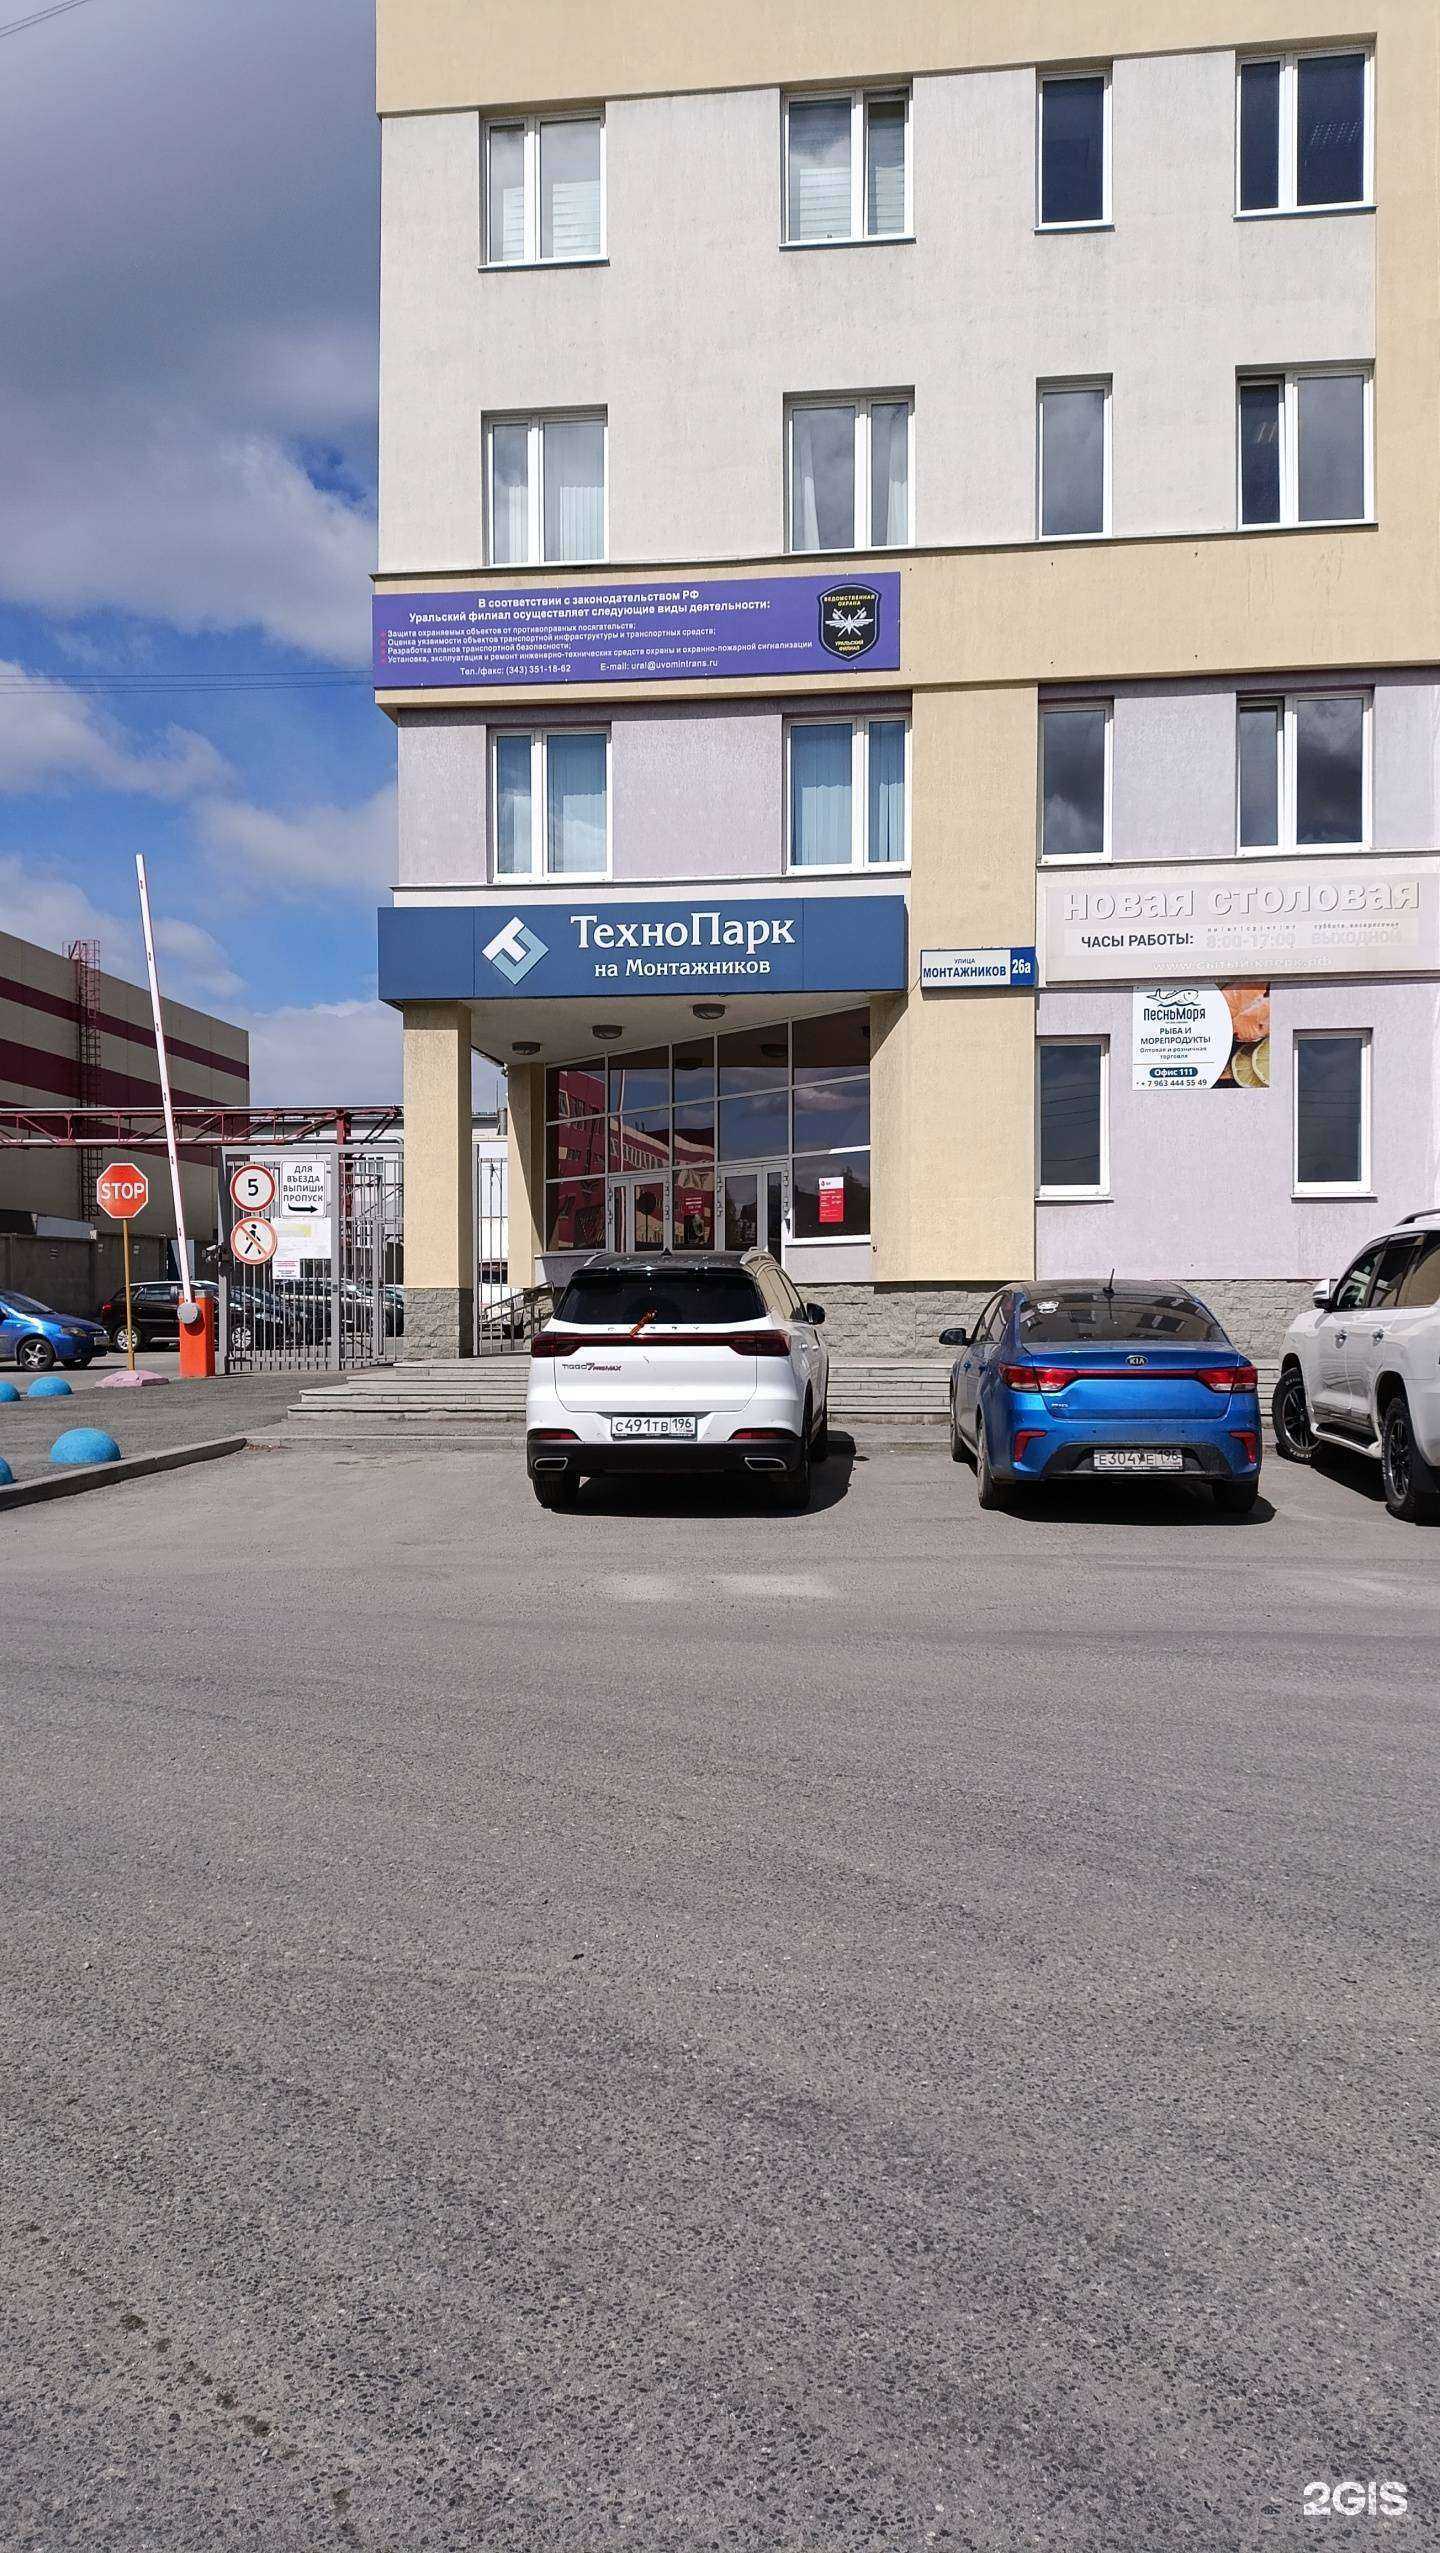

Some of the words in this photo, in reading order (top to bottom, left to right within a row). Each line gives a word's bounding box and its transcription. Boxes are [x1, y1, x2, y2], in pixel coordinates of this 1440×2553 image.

[478, 598, 486, 608] В
[488, 597, 562, 609] соответствии
[563, 596, 571, 605] с
[572, 592, 681, 605] законодательством
[682, 589, 700, 600] РФ
[409, 611, 467, 624] Уральский
[468, 610, 511, 622] филиал
[513, 608, 589, 621] осуществляет
[591, 605, 656, 618] следующие
[657, 604, 688, 614] виды
[689, 600, 771, 613] деятельности:
[387, 630, 417, 639] Защита
[460, 665, 504, 677] Тел./факс:
[505, 664, 528, 676] (343)
[600, 661, 630, 671] E-mail:
[570, 911, 796, 955] ТехноПарк
[1081, 934, 1124, 948] ЧАСЫ
[1128, 932, 1195, 947] РАБОТЫ:
[594, 962, 618, 978] на
[626, 957, 772, 978] Монтажников
[923, 965, 1007, 978] МОНТАЖНИКОВ
[1011, 958, 1031, 975] 26а
[1159, 1027, 1183, 1035] РЫБА
[1140, 1036, 1211, 1045] МОРЕПРОДУКТЫ
[1154, 1068, 1178, 1078] Офис
[1180, 1068, 1193, 1076] 111
[294, 1165, 313, 1174] ДЛЯ
[287, 1175, 321, 1184] ВЪЕЗДА
[100, 1182, 145, 1200] STOP
[247, 1178, 259, 1197] 5
[283, 1194, 324, 1202] ПРОПУСК
[1129, 1357, 1145, 1365] KIA
[672, 1418, 692, 1429] 196
